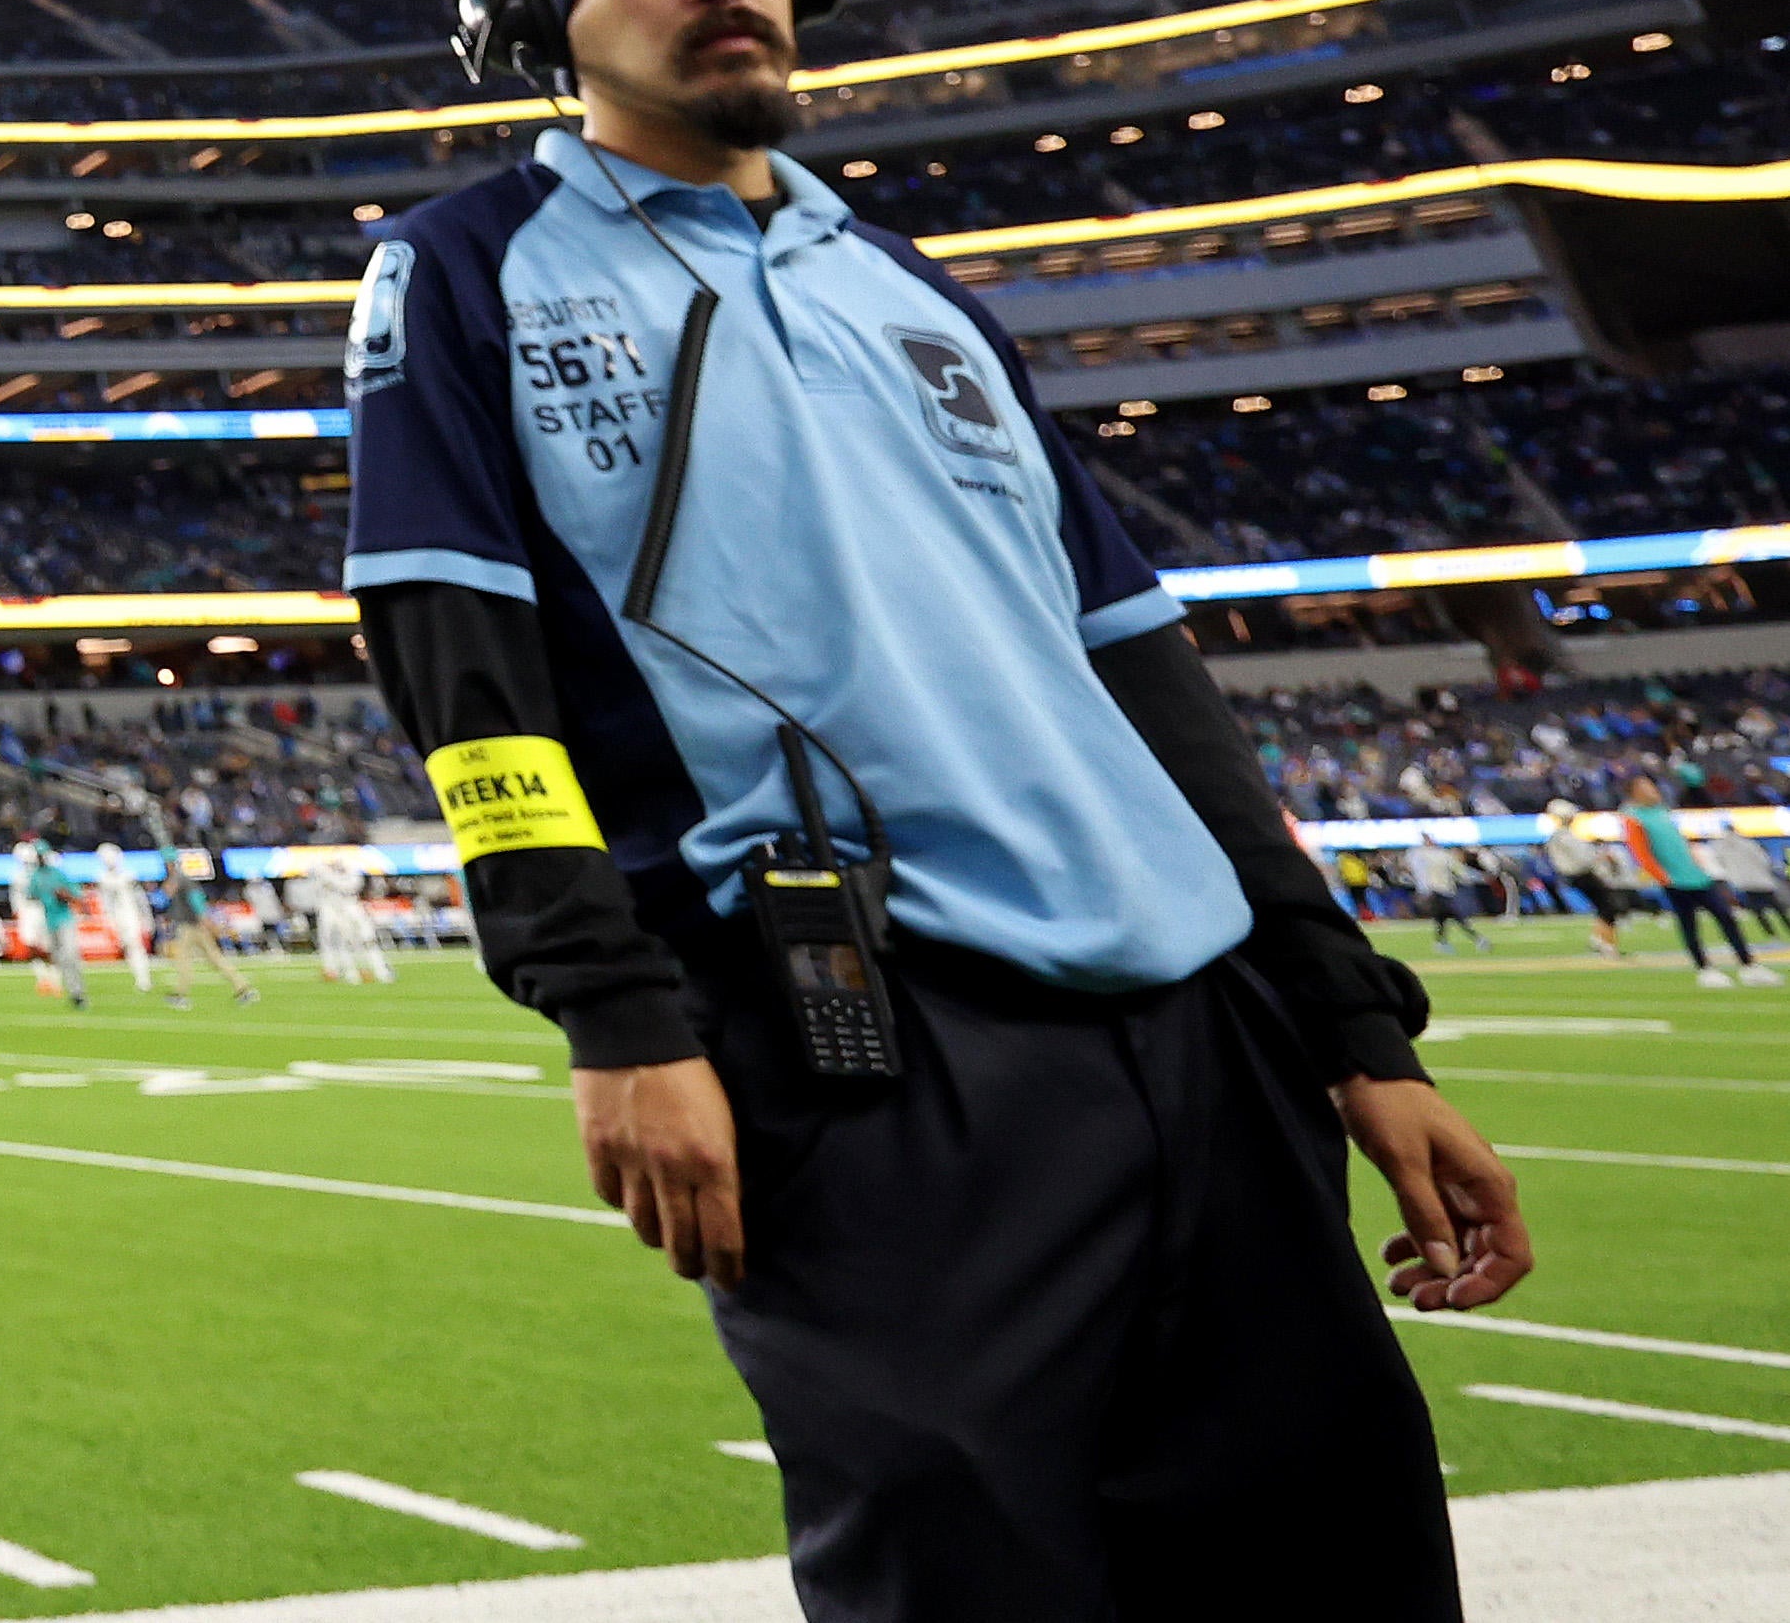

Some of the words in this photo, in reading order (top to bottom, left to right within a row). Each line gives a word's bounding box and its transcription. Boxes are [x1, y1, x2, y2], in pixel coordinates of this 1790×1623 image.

[517, 332, 646, 391] 5671
[533, 388, 665, 434] STAFF
[585, 432, 642, 473] 01
[445, 775, 515, 810] WEEK
[515, 770, 548, 797] 14
